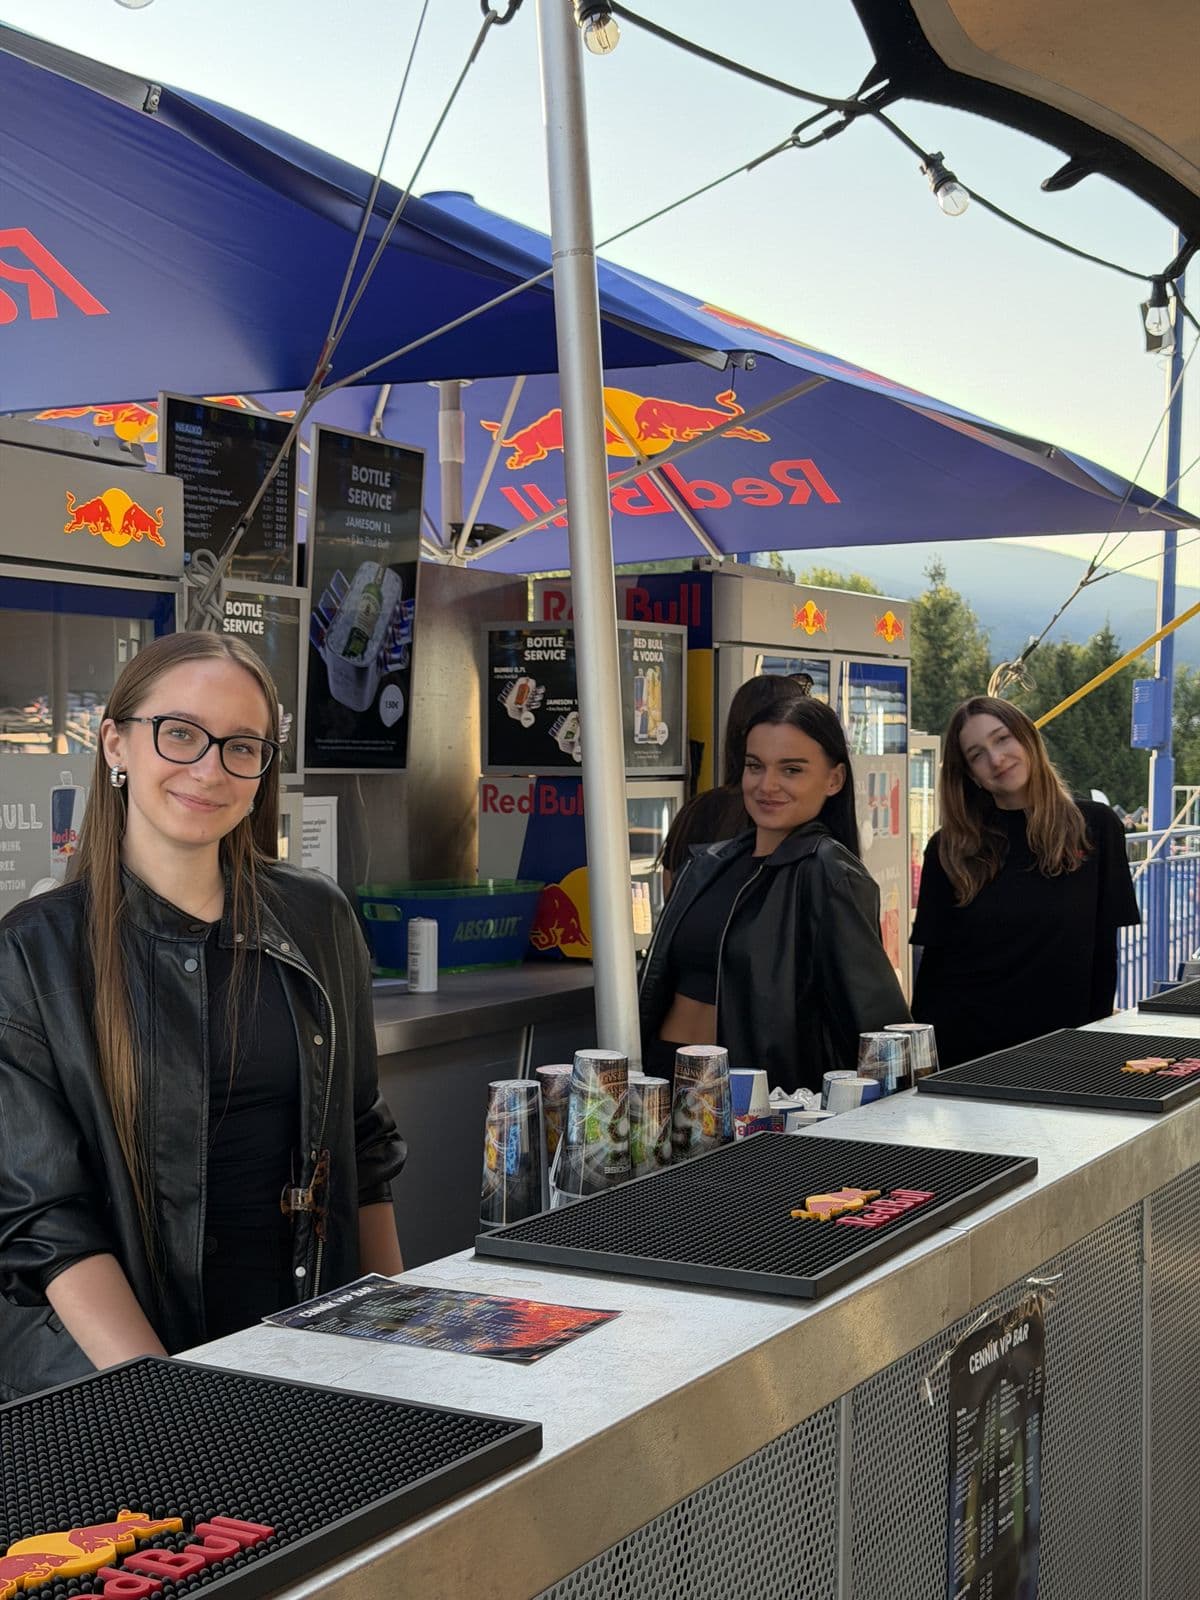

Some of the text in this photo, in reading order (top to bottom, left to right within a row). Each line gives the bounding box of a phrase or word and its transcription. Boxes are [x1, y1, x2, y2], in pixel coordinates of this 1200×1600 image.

[351, 464, 392, 488] BOTTLE
[347, 487, 392, 511] SERVICE
[345, 516, 381, 532] JAMESON
[225, 601, 263, 617] BOTTLE
[626, 583, 701, 627] Bull
[222, 618, 265, 635] SERVICE
[526, 637, 564, 648] BOTTLE
[633, 638, 664, 650] RED BULL
[524, 650, 566, 661] SERVICE
[632, 651, 664, 662] & VODKA
[482, 783, 584, 816] Red Bul
[0, 860, 16, 871] REE
[969, 1339, 1000, 1375] CENNÍK
[1012, 1323, 1030, 1348] BAR
